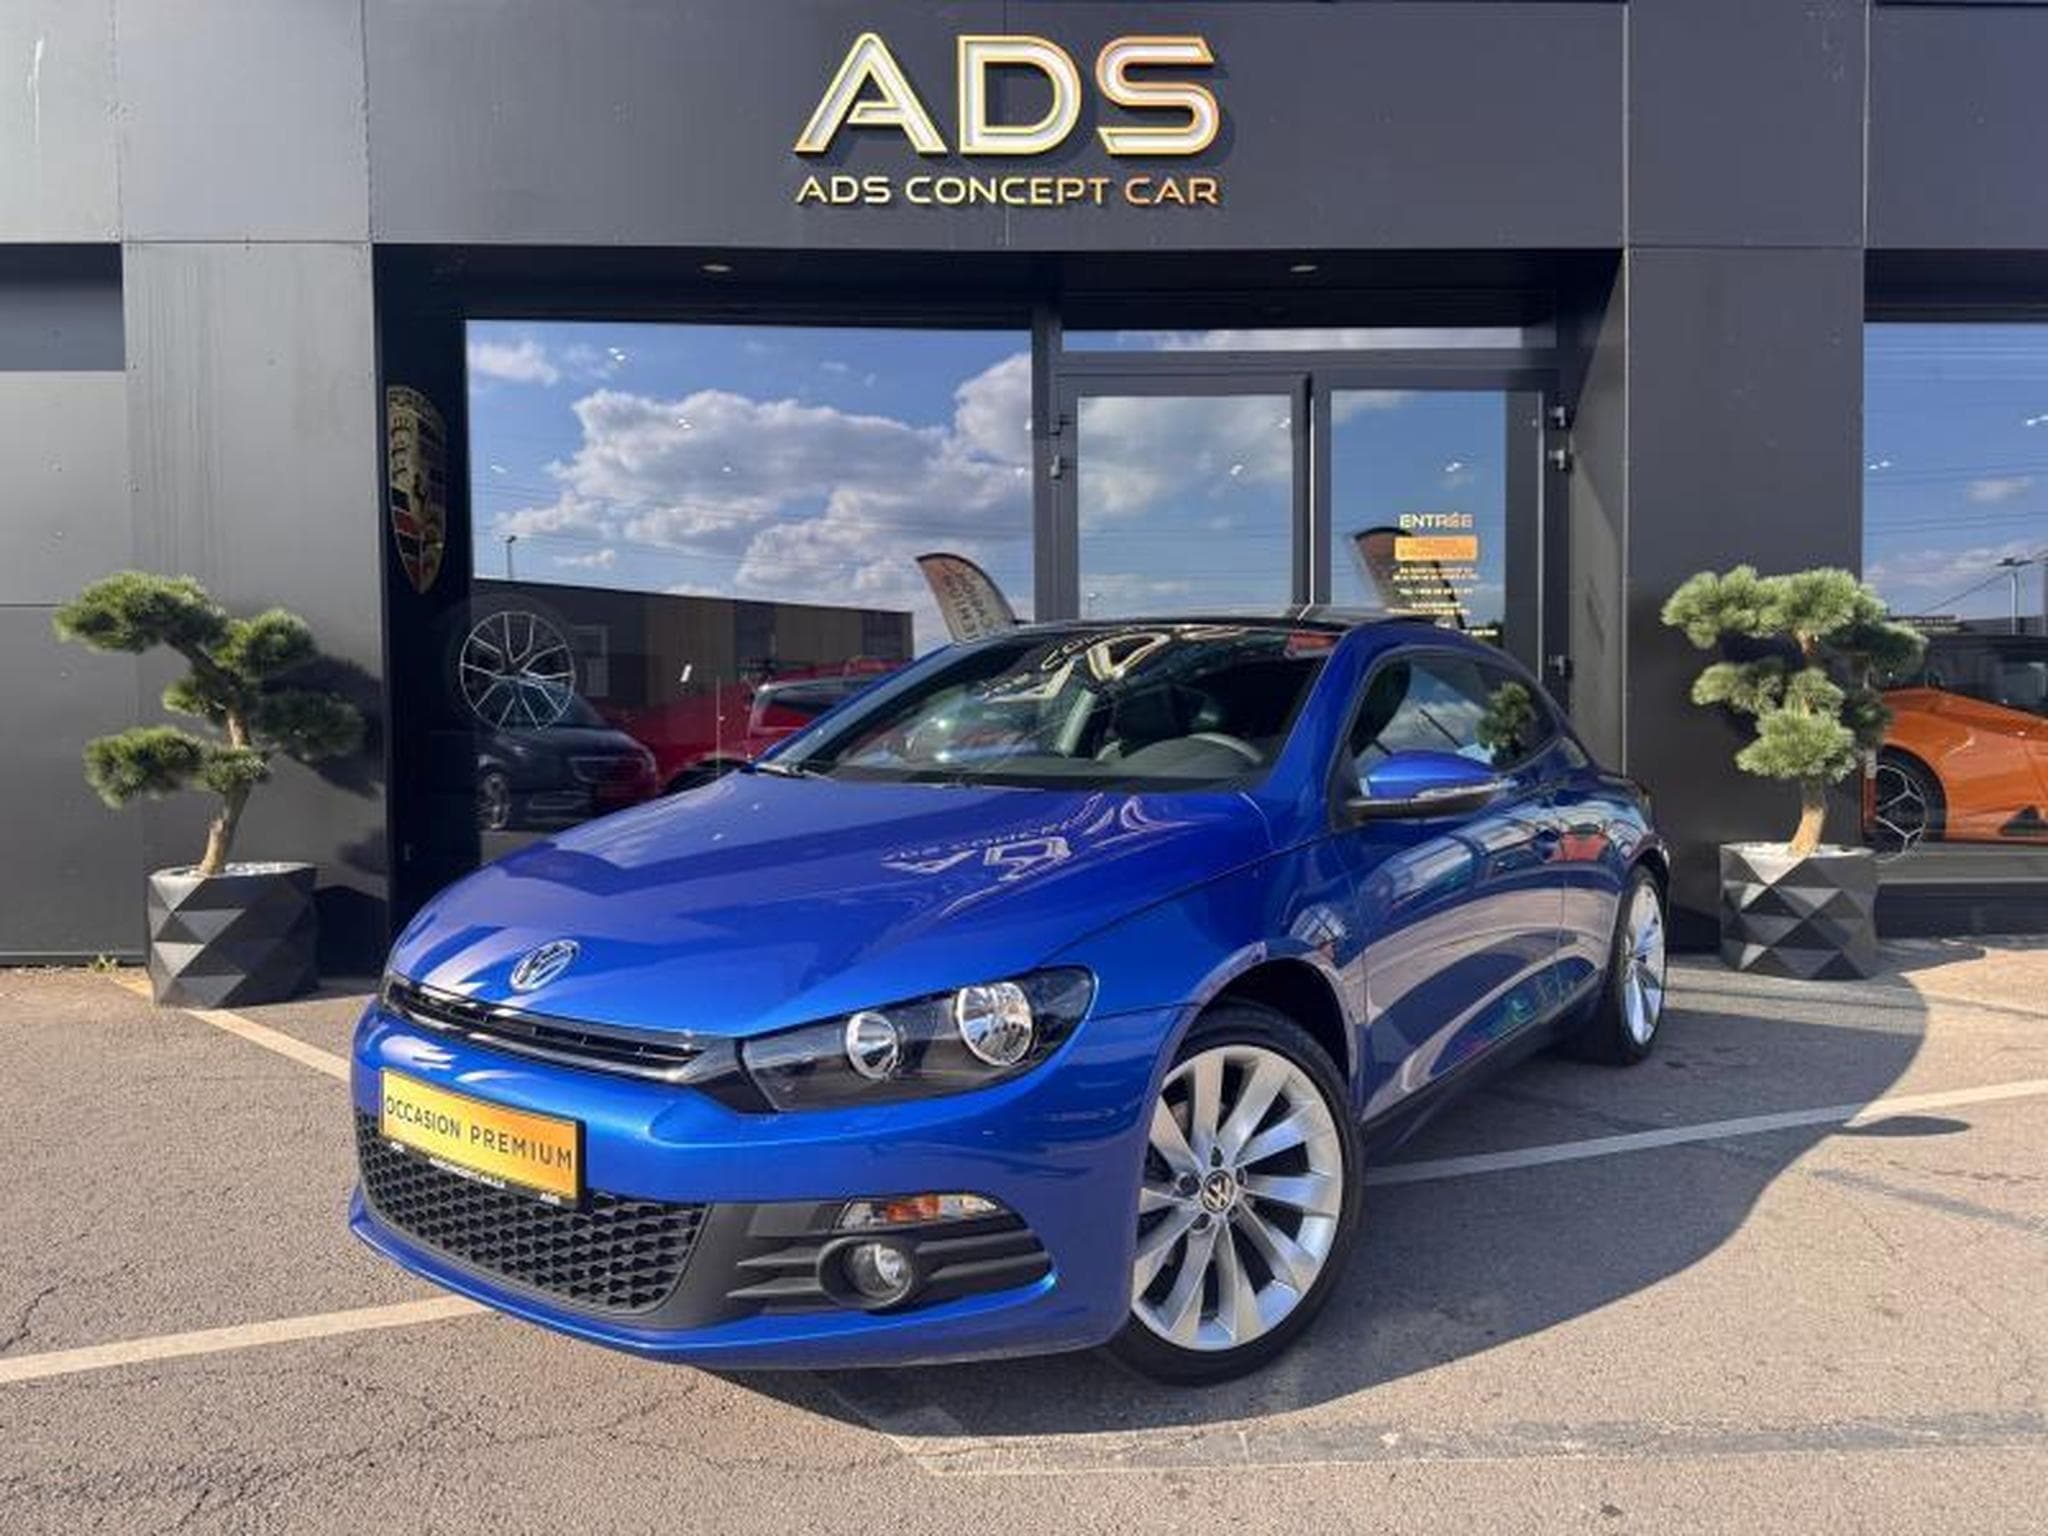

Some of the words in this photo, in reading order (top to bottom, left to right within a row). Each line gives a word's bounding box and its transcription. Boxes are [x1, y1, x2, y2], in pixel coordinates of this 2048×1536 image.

[793, 32, 1220, 155] ADS
[797, 175, 891, 204] ADS
[904, 176, 1111, 205] CONCEPT
[1124, 176, 1220, 206] CAR
[385, 1095, 461, 1138] OCCASION
[470, 1126, 573, 1172] PREMIUM
